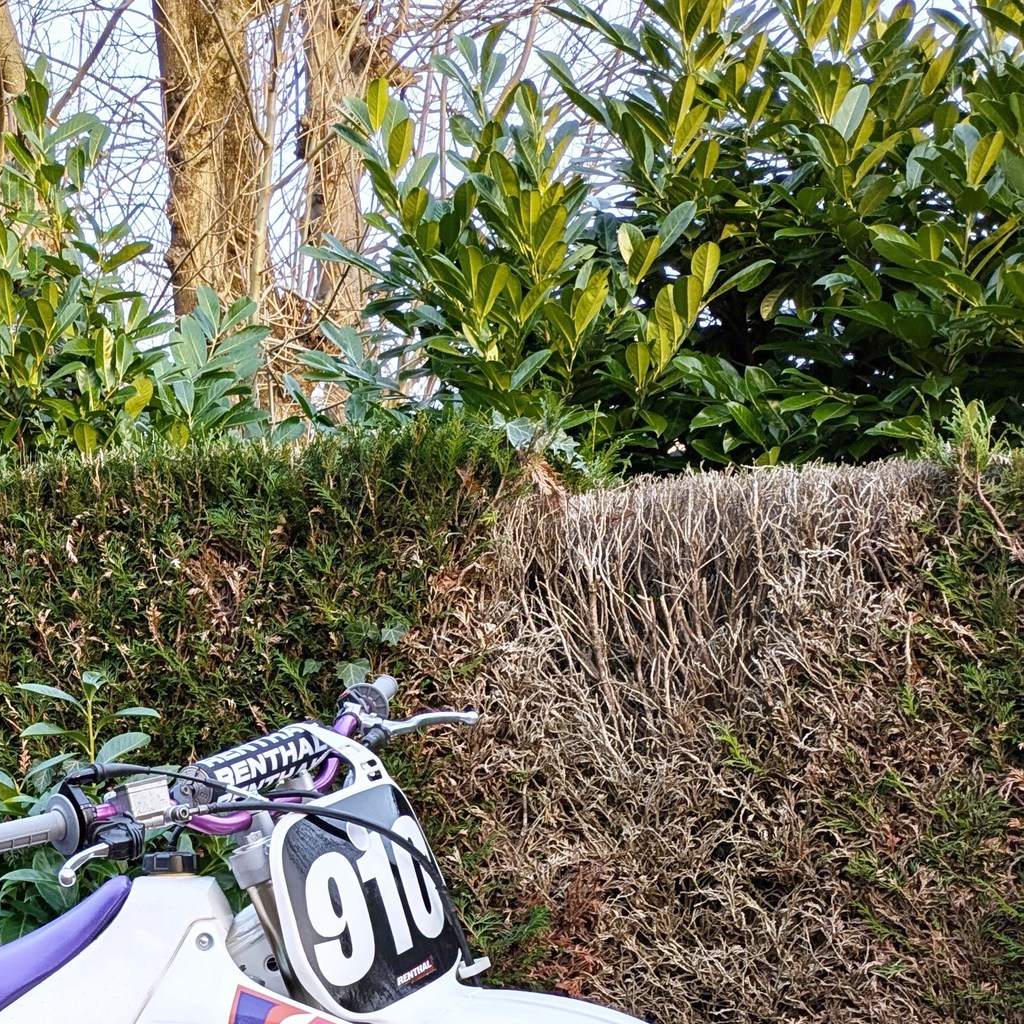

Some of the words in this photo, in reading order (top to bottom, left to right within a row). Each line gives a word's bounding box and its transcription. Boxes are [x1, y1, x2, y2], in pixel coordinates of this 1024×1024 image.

[214, 735, 328, 786] RENTHAL
[305, 814, 445, 987] 910
[397, 959, 433, 987] RENTHAL
